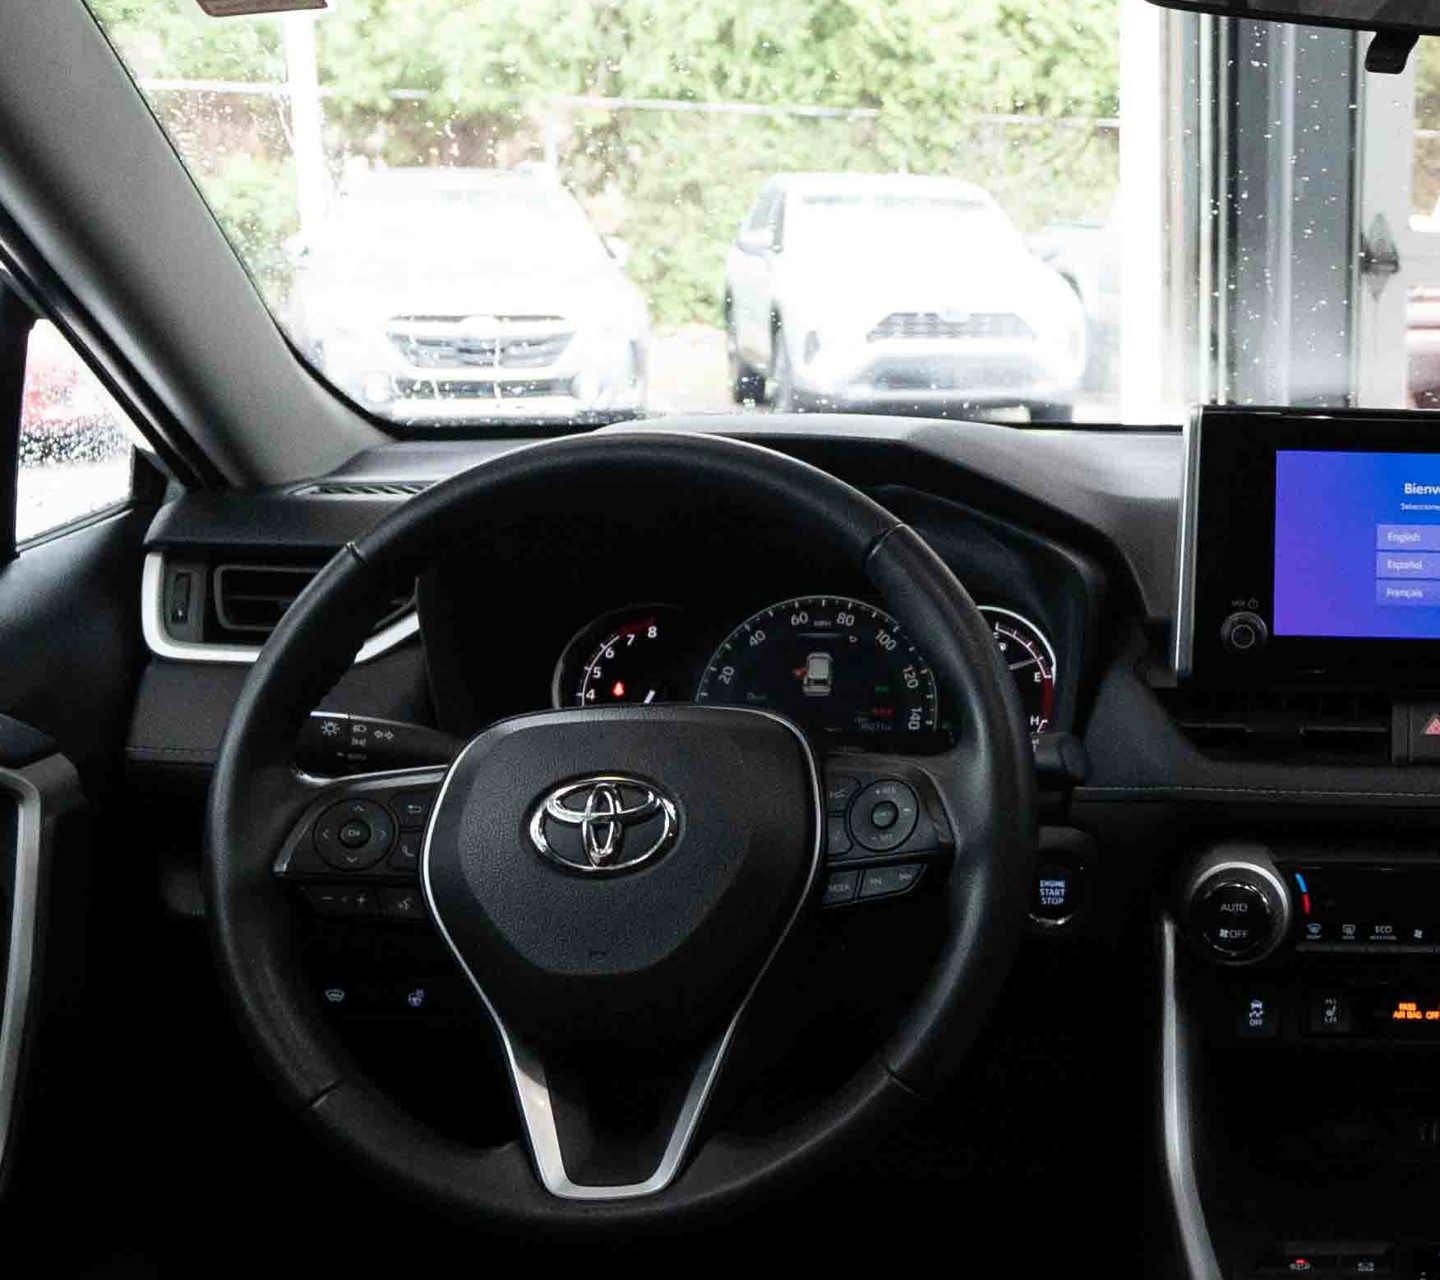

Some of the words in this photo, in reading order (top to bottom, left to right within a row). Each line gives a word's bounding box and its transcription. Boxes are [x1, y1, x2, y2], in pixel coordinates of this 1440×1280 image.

[1386, 531, 1421, 544] English
[1386, 559, 1423, 572] Español
[1385, 587, 1423, 600] Français
[790, 611, 809, 627] 60
[835, 612, 856, 628] 80
[647, 625, 658, 639] 8
[747, 629, 767, 648] 40
[626, 633, 636, 647] 7
[874, 628, 897, 652] 100
[605, 647, 615, 659] 6
[592, 665, 602, 679] 5
[718, 665, 735, 685] 20
[902, 664, 919, 690] 120
[1033, 671, 1042, 683] E
[585, 688, 596, 701] 4
[907, 705, 923, 731] 140
[1039, 887, 1066, 897] START
[1040, 897, 1065, 906] STOP
[1220, 902, 1249, 913] AUTO
